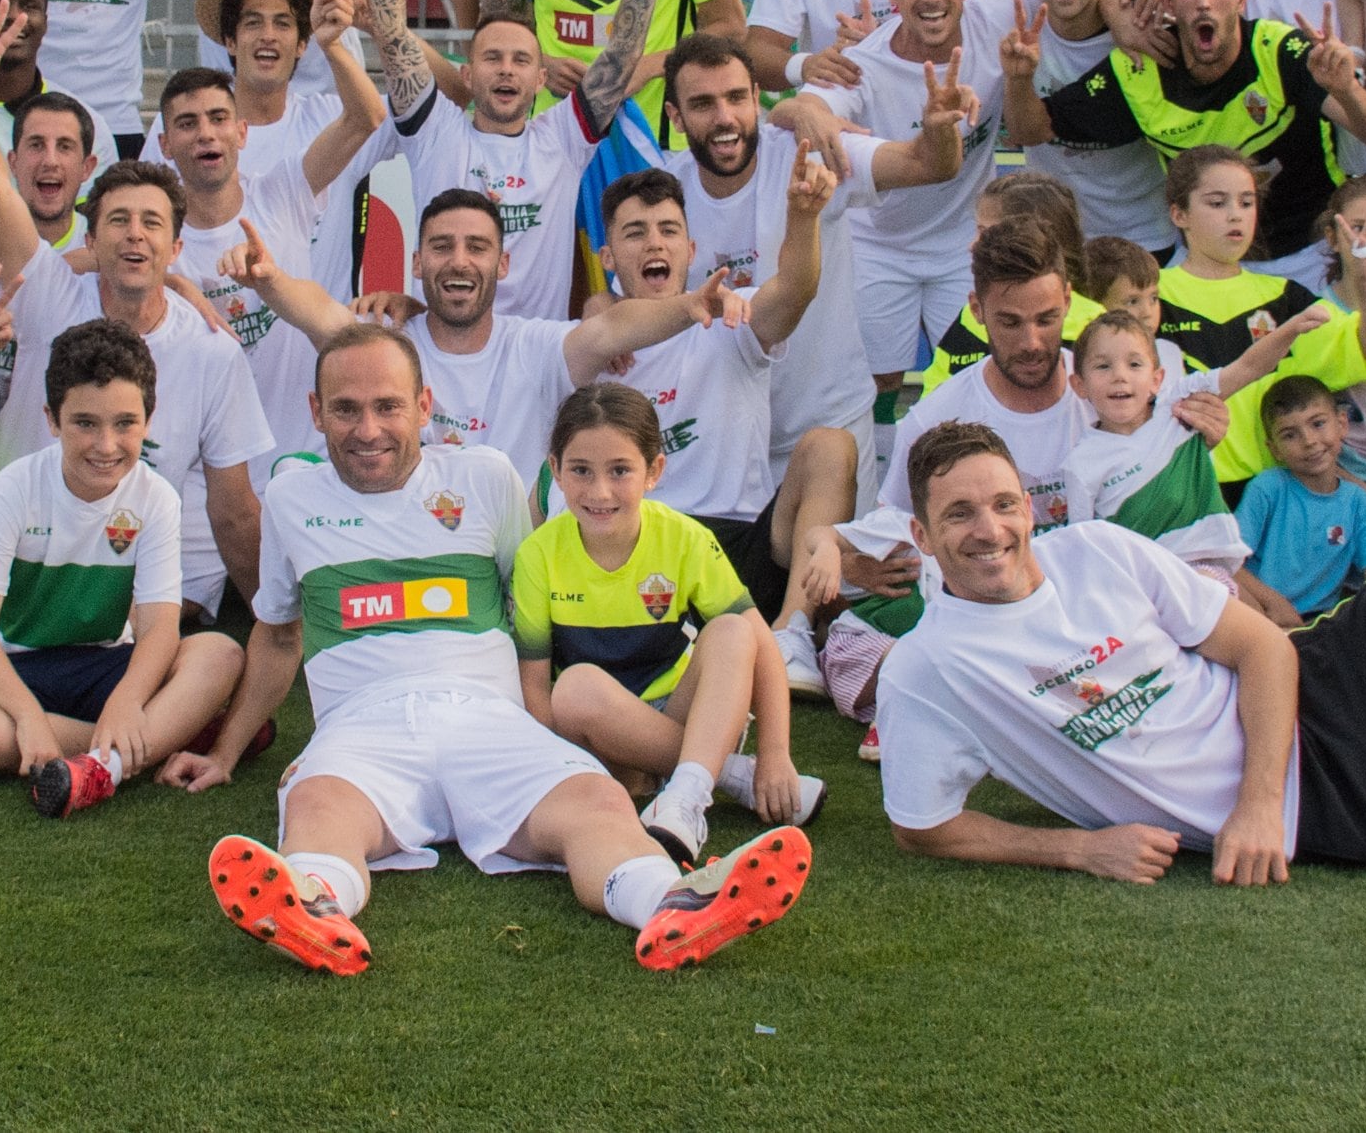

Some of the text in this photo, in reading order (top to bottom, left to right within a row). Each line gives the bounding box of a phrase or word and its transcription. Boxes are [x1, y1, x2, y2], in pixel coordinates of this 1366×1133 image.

[559, 18, 588, 40] TM
[1160, 119, 1204, 136] KELME
[1159, 320, 1202, 334] KELME
[657, 388, 678, 405] 2A
[431, 414, 470, 431] CENSO
[1102, 463, 1143, 488] KELME
[305, 515, 365, 529] KELME
[550, 591, 586, 603] ELME
[348, 594, 394, 618] TM
[1089, 635, 1124, 665] 2A
